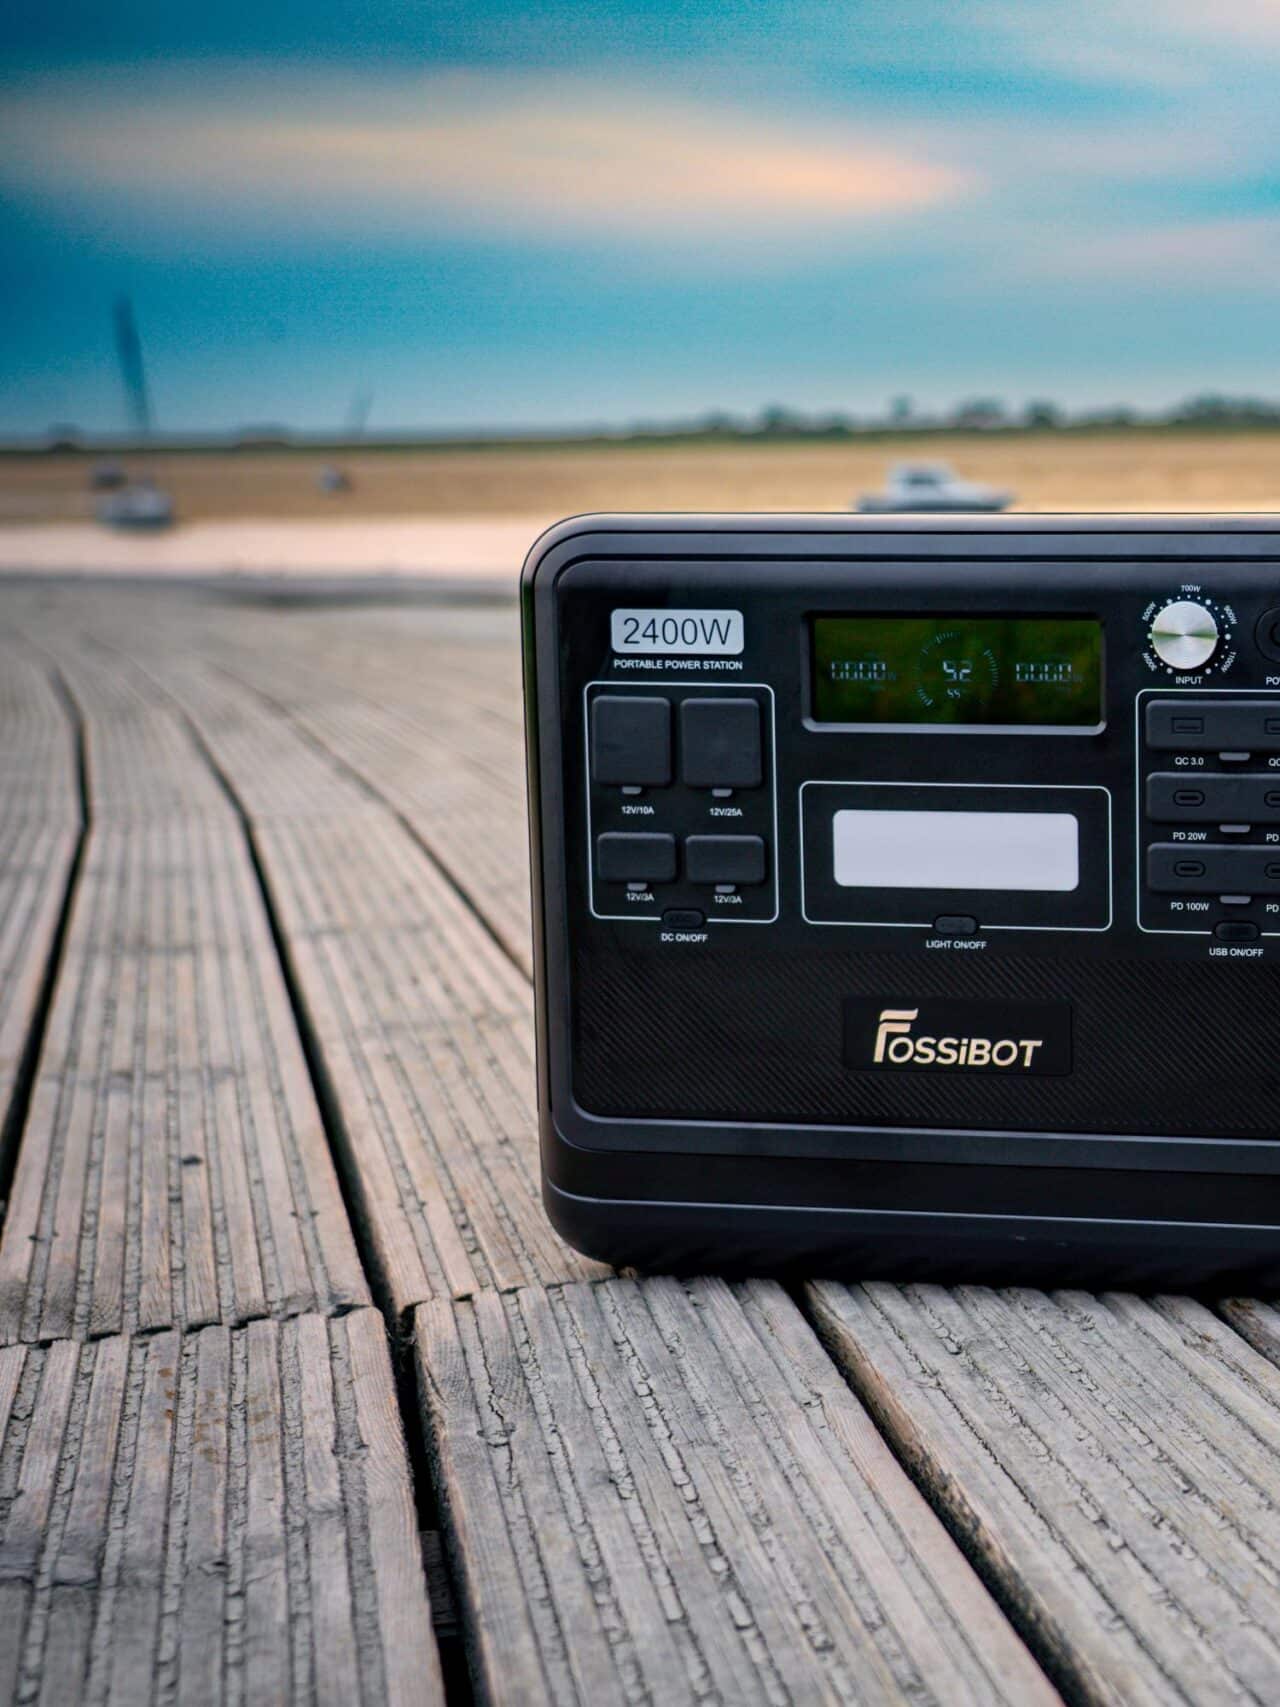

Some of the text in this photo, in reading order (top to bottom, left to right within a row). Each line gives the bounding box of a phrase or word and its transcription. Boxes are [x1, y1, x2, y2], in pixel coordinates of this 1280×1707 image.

[623, 617, 732, 646] 2400W
[613, 659, 743, 670] PORTABLE POWER STATION
[1175, 676, 1203, 685] INPUT
[1174, 756, 1204, 766] QC 3.0
[621, 805, 654, 815] 12V/10A
[709, 807, 743, 817] 12V/25A
[1172, 831, 1207, 841] PD 20W
[1266, 833, 1280, 842] PD
[1170, 902, 1210, 912] PD 100W
[1266, 904, 1280, 913] PD
[661, 933, 709, 943] DC ON/OFF
[926, 940, 988, 950] LIGHT ON/OFF
[1209, 948, 1264, 958] USB ON/OFF
